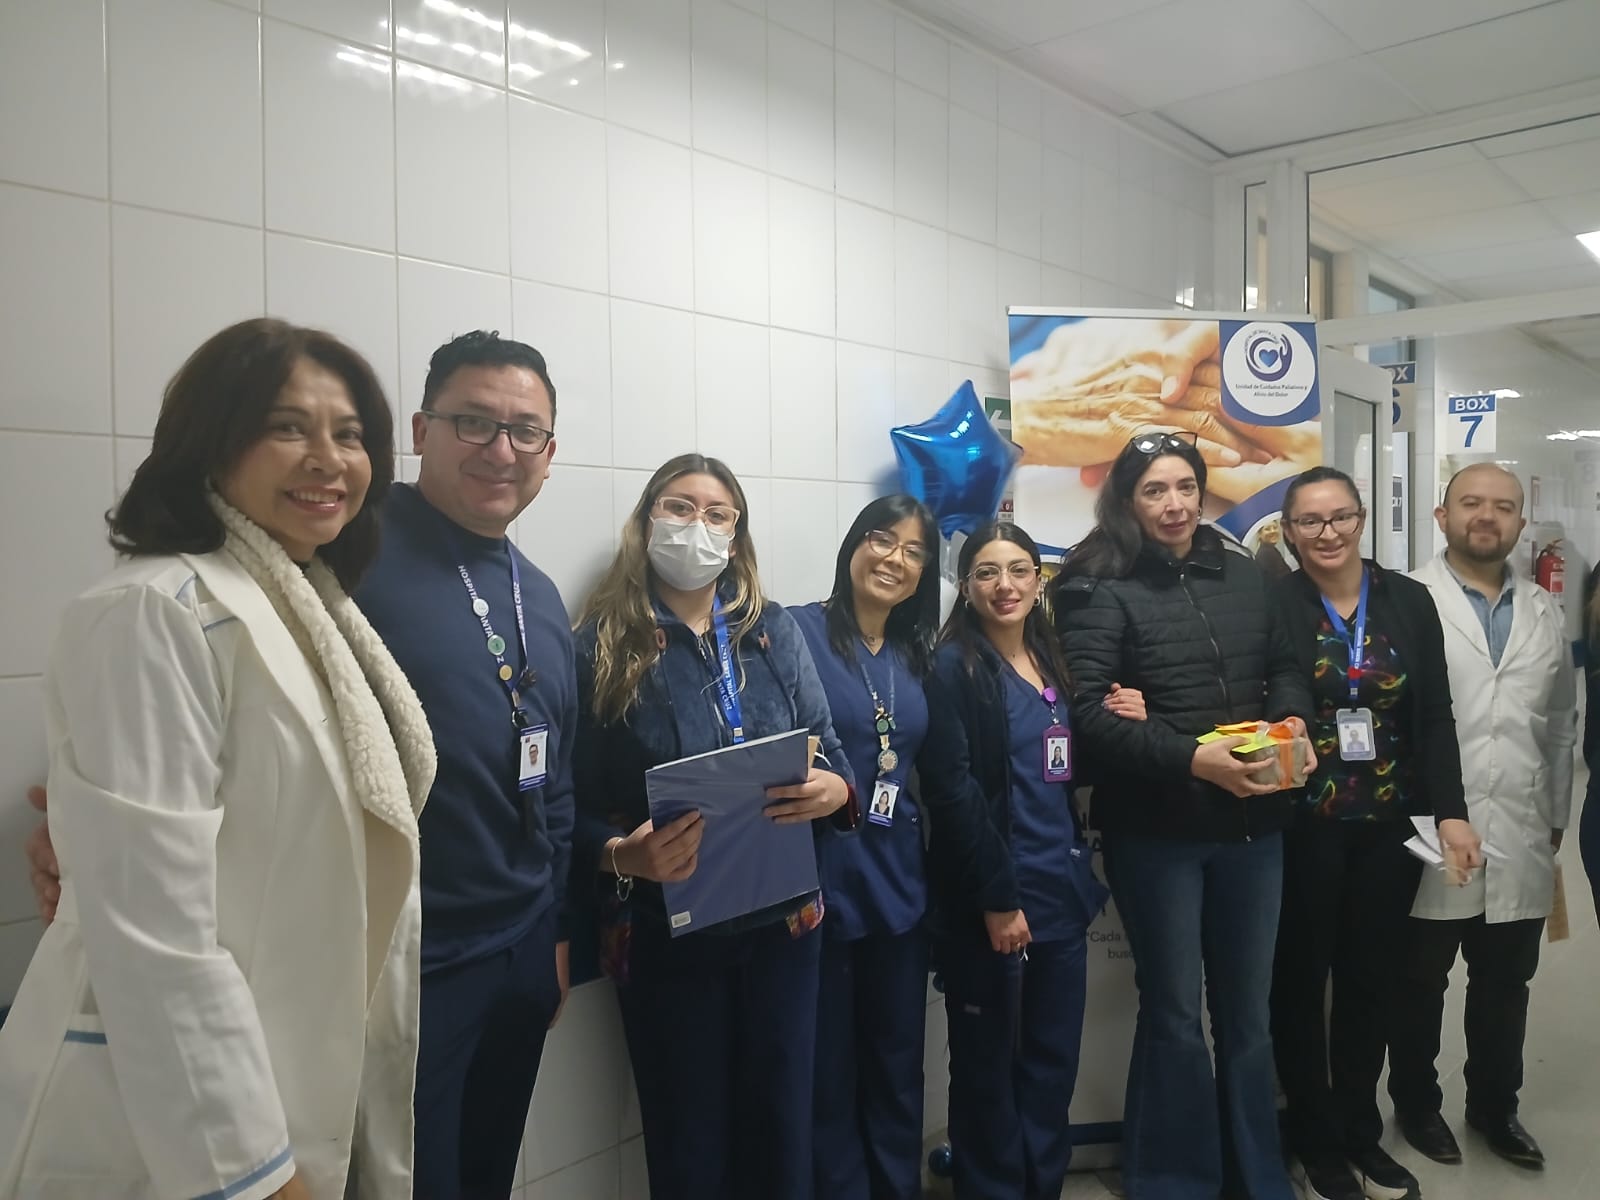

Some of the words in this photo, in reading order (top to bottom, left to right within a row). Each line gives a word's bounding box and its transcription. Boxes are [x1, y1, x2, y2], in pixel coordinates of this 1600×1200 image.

[1455, 397, 1490, 412] BOX
[1460, 415, 1484, 448] 7
[458, 565, 479, 601] HOSPITA
[480, 615, 494, 638] ANTA
